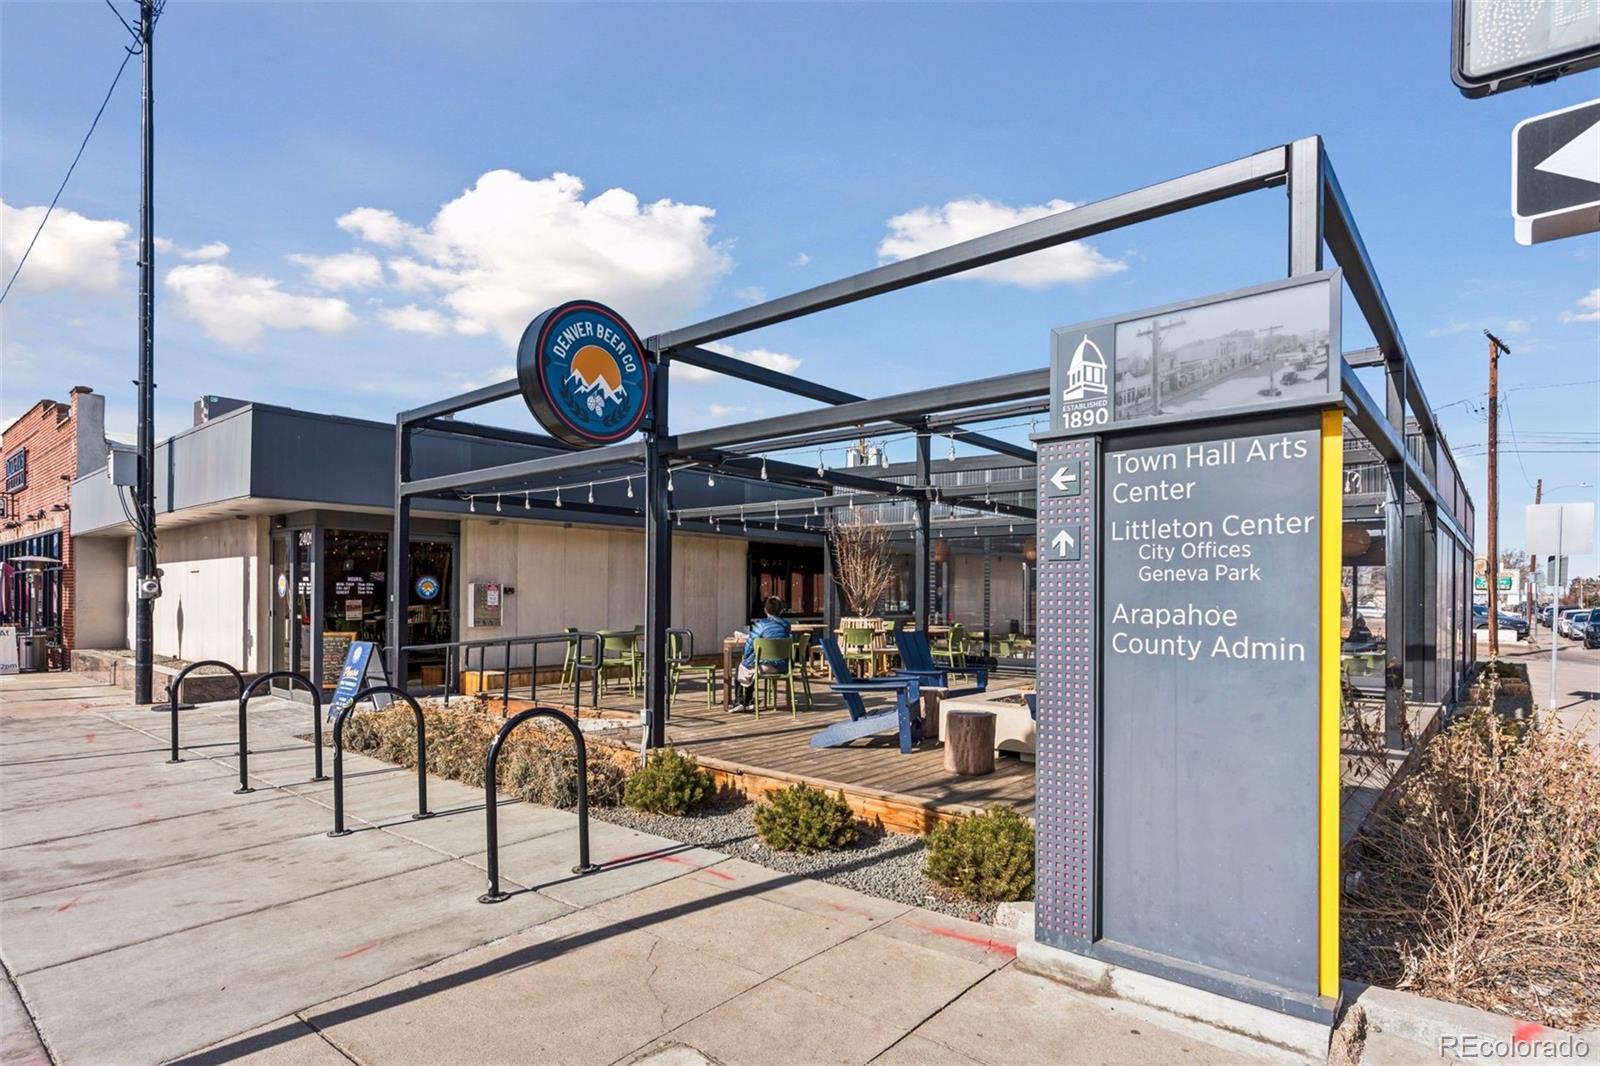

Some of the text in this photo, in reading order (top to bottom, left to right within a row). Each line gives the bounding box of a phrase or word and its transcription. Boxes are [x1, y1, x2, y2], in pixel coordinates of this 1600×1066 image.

[553, 321, 637, 373] DENVER BEER CO
[1062, 399, 1108, 412] ESTABLISHED
[1062, 407, 1109, 429] 1890
[1112, 436, 1308, 475] Town Hall Arts
[1112, 480, 1196, 504] Center
[1111, 513, 1315, 541] Littleton Center
[1138, 541, 1252, 562] City Offices
[1138, 564, 1262, 582] Geneva Park
[1111, 603, 1238, 629] Arapahoe
[1112, 632, 1305, 662] County Admin
